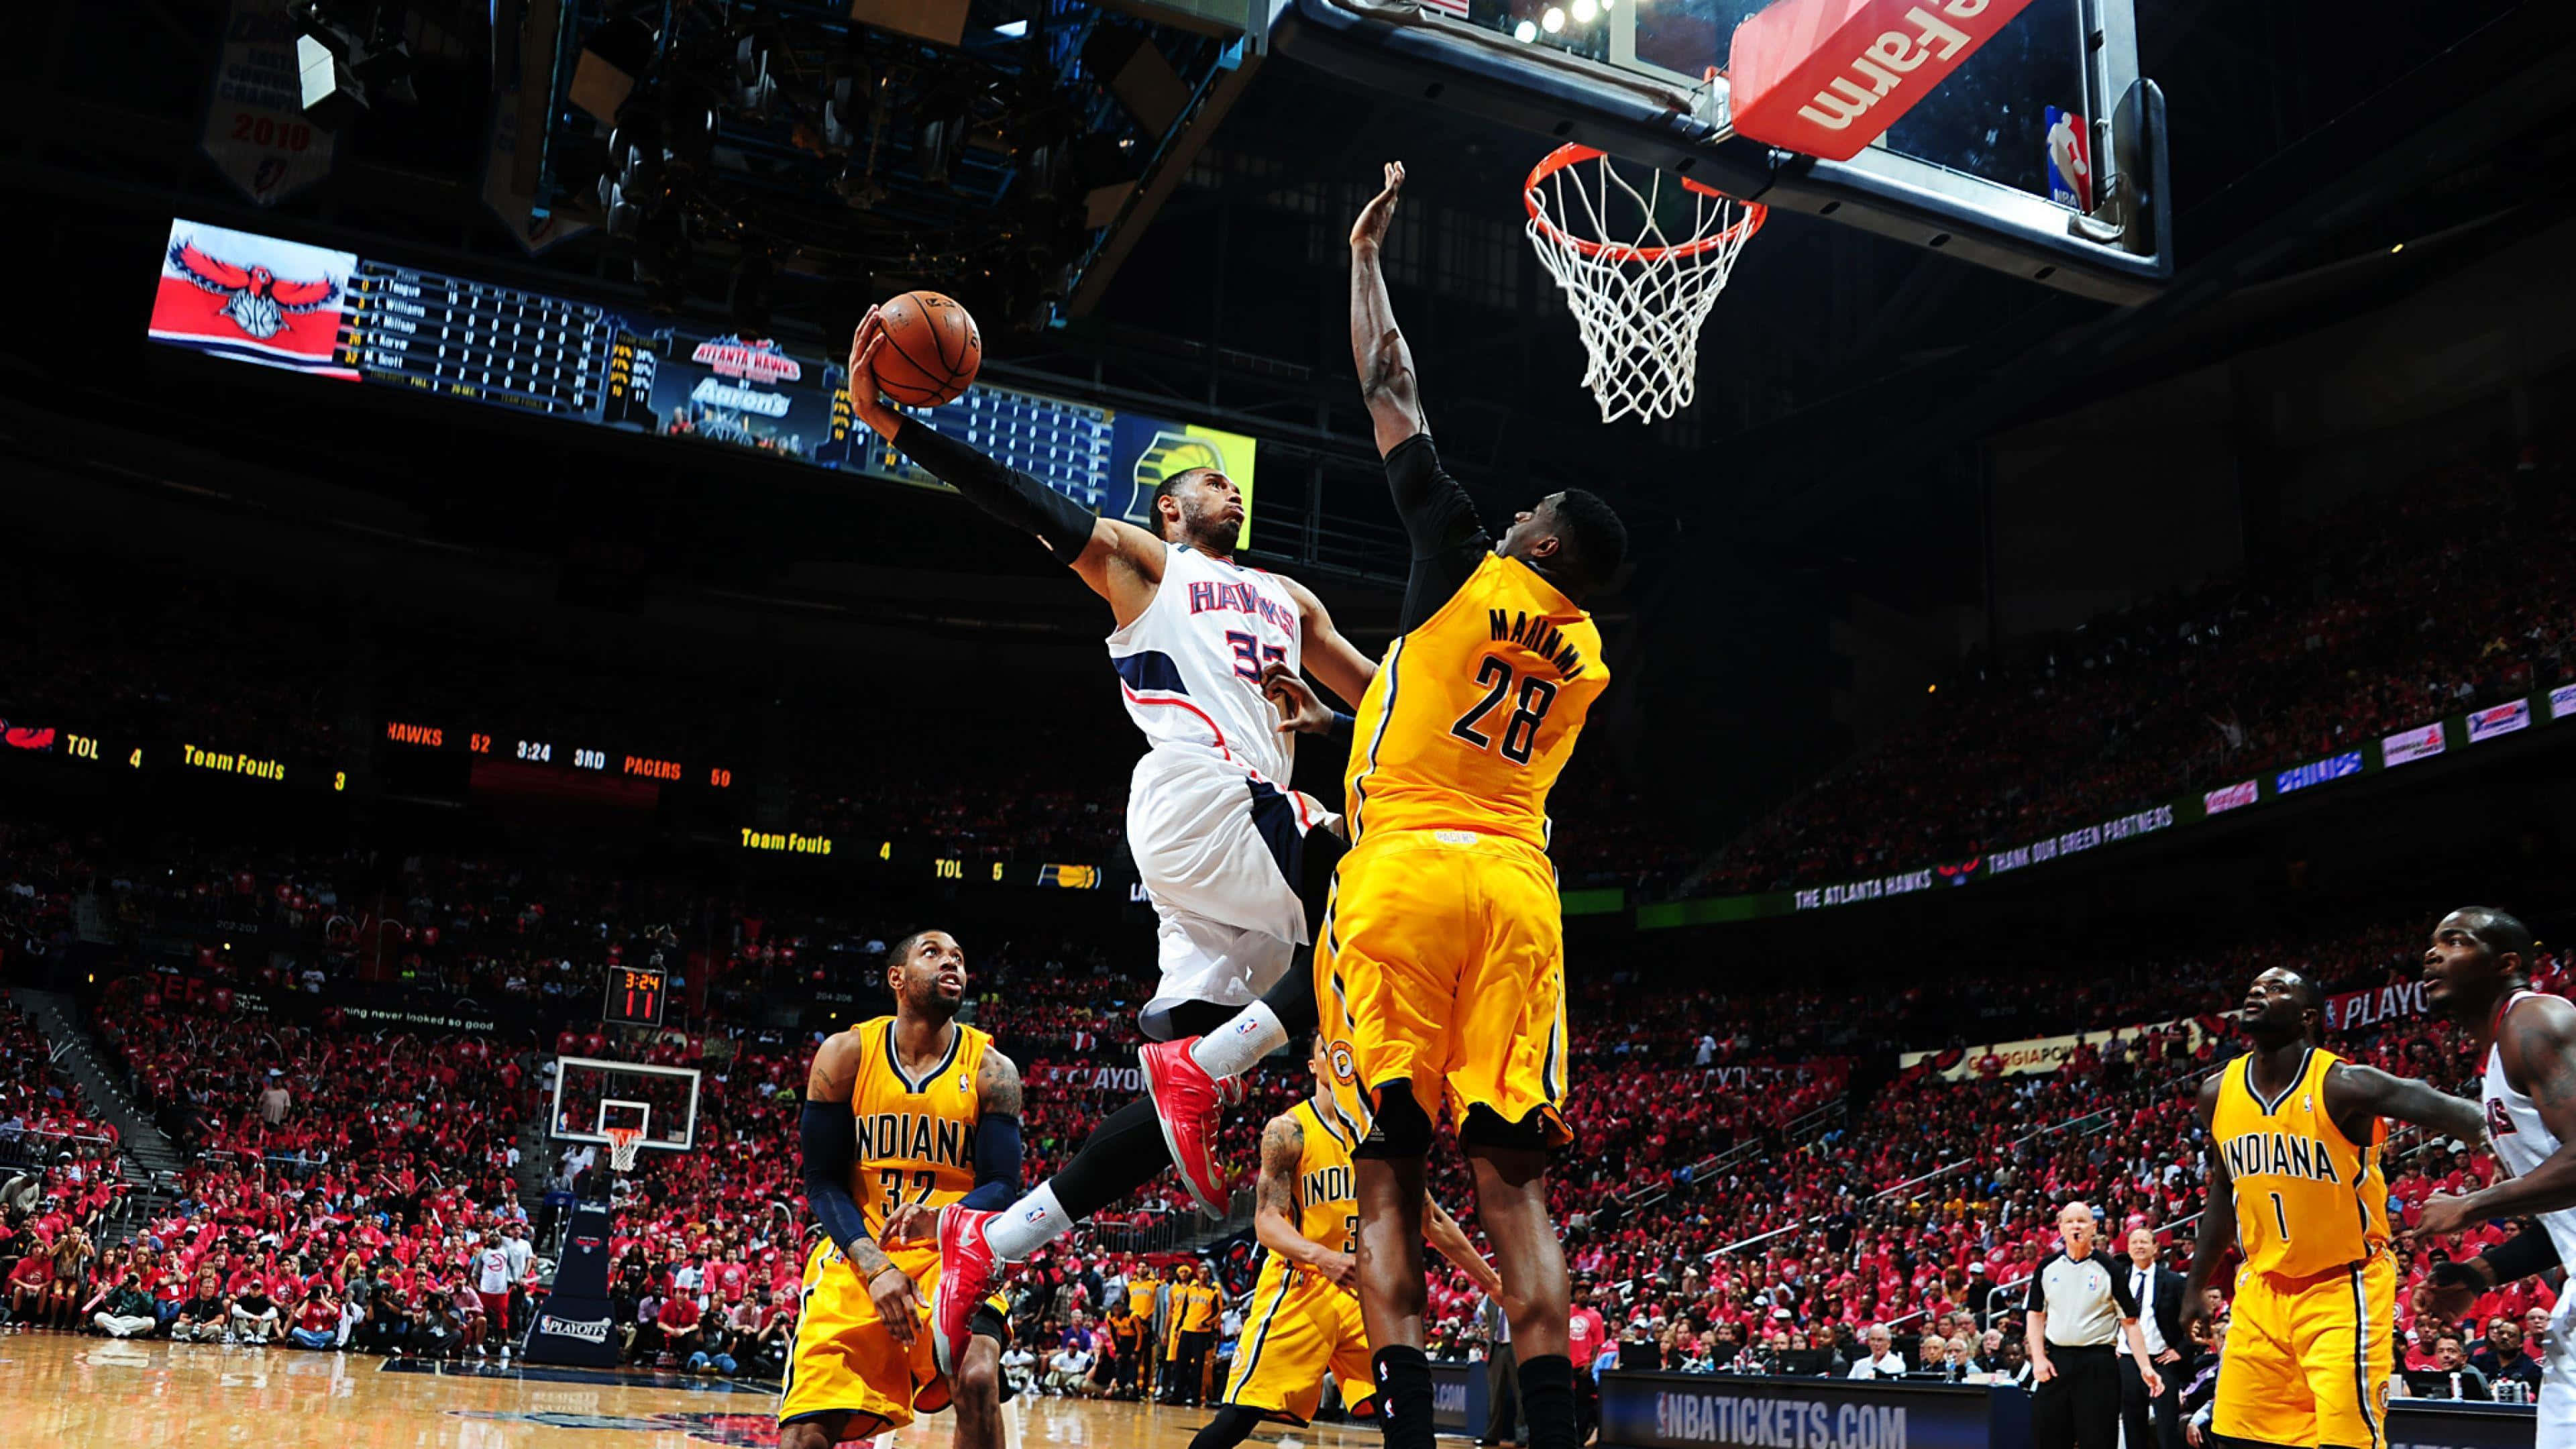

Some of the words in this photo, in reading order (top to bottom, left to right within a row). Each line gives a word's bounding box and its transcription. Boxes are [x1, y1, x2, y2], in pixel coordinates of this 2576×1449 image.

[1797, 6, 1972, 129] Farm
[231, 113, 310, 151] 2010
[386, 297, 426, 318] Williams
[389, 278, 422, 299] Teague
[379, 333, 409, 352] Korver
[383, 315, 417, 336] Millsap
[378, 352, 402, 370] Scott
[698, 345, 749, 366] ATLANTA
[754, 353, 798, 376] HAWKS
[1449, 653, 1559, 767] 28
[67, 734, 99, 761] TOL
[129, 747, 142, 769] 4
[184, 743, 234, 773] Team
[236, 753, 286, 781] Fouls
[334, 771, 346, 792] 3
[386, 720, 443, 747] HAWKS
[470, 733, 491, 755] 52
[517, 740, 552, 763] 3:24
[574, 748, 605, 771] 3RD
[624, 755, 682, 781] PACERS
[741, 827, 786, 851] Team
[788, 833, 832, 855] Fouls
[879, 841, 892, 862] 4
[935, 859, 963, 879] TOL
[991, 861, 1004, 881] 5
[1794, 888, 1821, 912] THE
[1823, 877, 1883, 906] ATLANTA
[1885, 868, 1933, 897] HAWKS
[1988, 845, 2031, 875] THANK
[2032, 837, 2058, 864] OUR
[2059, 825, 2102, 857] GREEN
[2103, 804, 2174, 842] PARTNERS
[625, 972, 660, 991] 3:24
[371, 1010, 402, 1021] never
[407, 1012, 445, 1026] looked
[448, 1018, 462, 1028] so
[464, 1019, 494, 1032] good
[625, 989, 654, 1018] 11
[854, 1112, 977, 1169] NDIANA
[2222, 1132, 2341, 1186] INDIANA
[1344, 1215, 1359, 1255] 3
[2269, 1191, 2290, 1242] 1
[549, 1319, 608, 1339] PLAYOFFS
[1668, 1394, 1907, 1449] NBATICKETS.COM
